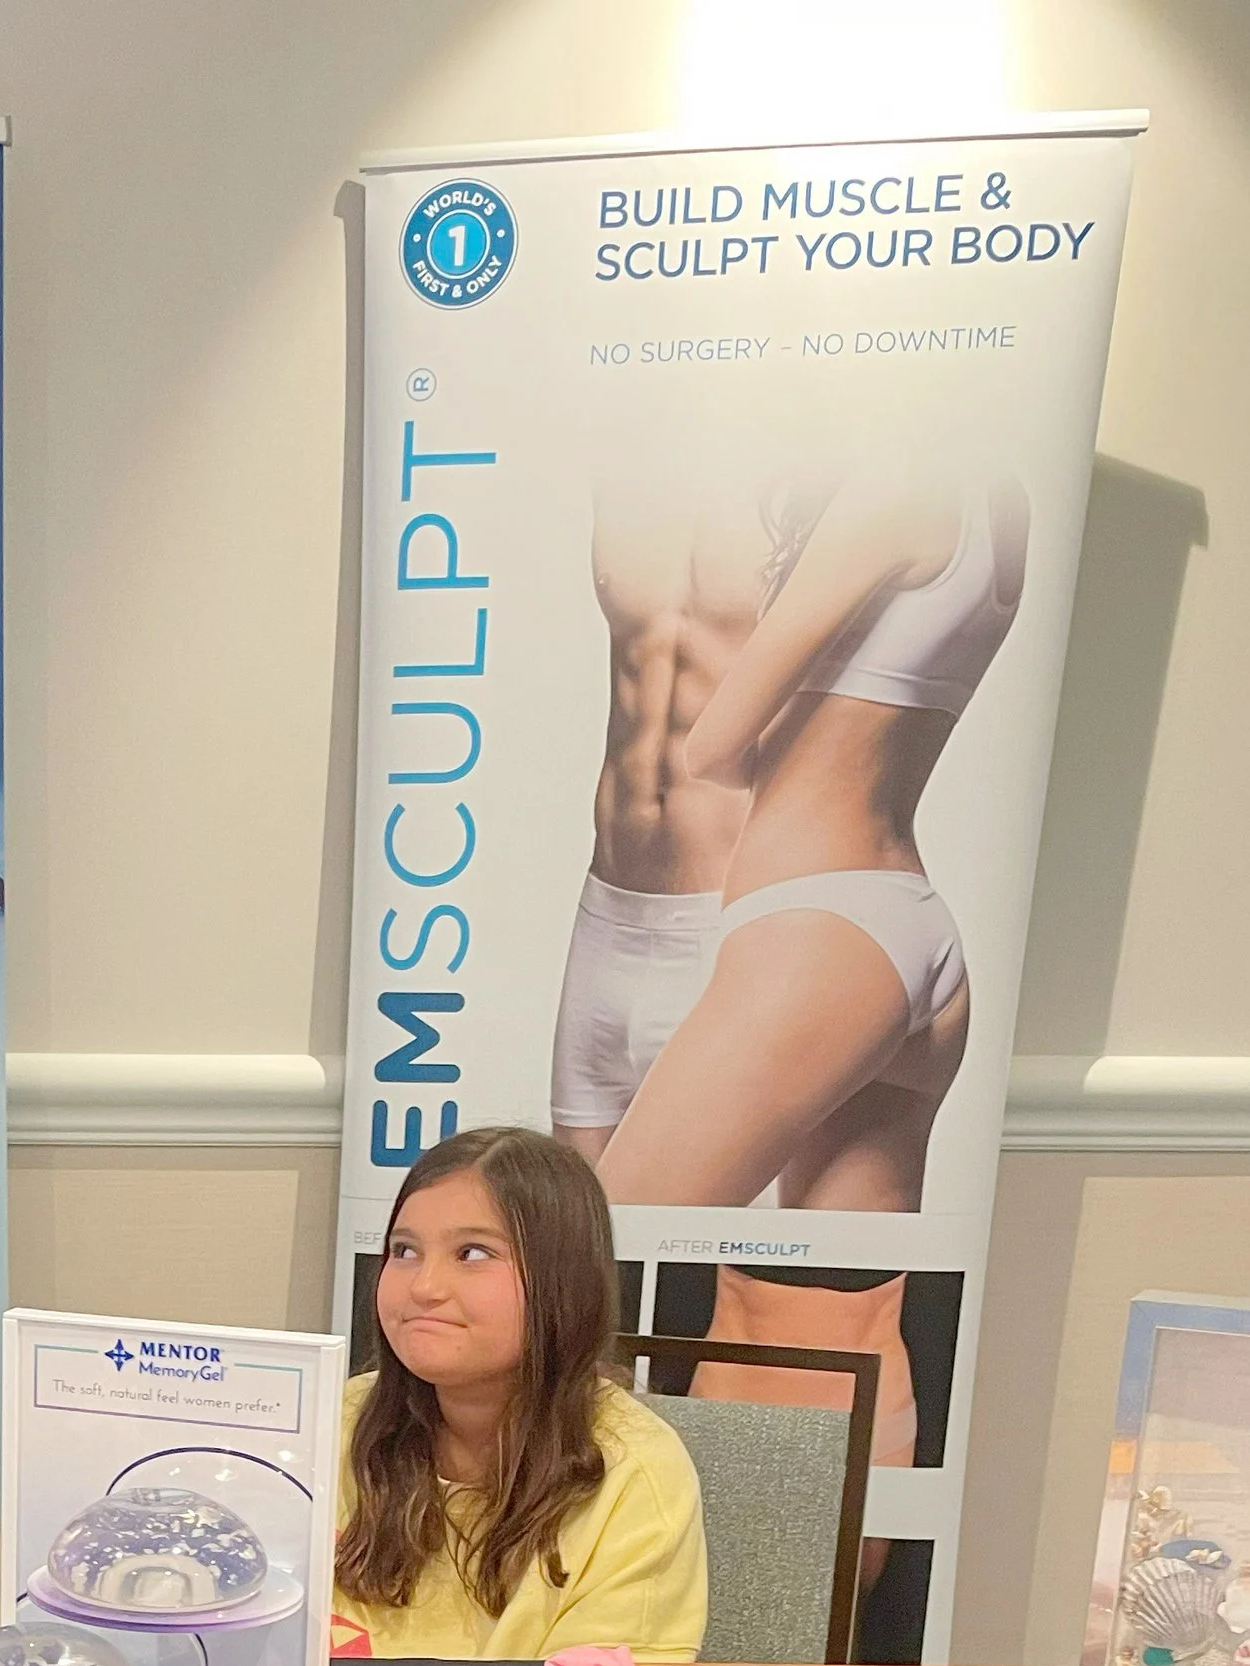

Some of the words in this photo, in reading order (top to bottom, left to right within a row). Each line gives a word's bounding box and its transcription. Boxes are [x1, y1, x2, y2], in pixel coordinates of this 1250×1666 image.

[423, 190, 496, 218] WORLD'S
[599, 185, 743, 229] BUILD
[762, 174, 964, 221] MUSCLE
[980, 172, 1012, 210] &
[448, 225, 466, 266] 1
[595, 235, 779, 282] SCULPT
[796, 229, 933, 271] YOUR
[951, 221, 1096, 265] BODY
[412, 260, 450, 296] FIRST
[451, 284, 463, 298] &
[466, 255, 502, 293] ONLY
[590, 343, 635, 365] NO
[640, 337, 771, 364] SURGERY
[802, 333, 844, 356] NO
[855, 325, 1017, 354] DOWNTIME
[354, 1231, 382, 1246] BEF
[657, 1239, 713, 1255] AFTER
[718, 1241, 811, 1257] EMSCULPT
[139, 1341, 222, 1363] MENTOR
[52, 1379, 77, 1394] The
[80, 1382, 105, 1398] soft,
[109, 1387, 153, 1402] natural
[156, 1389, 180, 1405] feel
[183, 1395, 232, 1410] women
